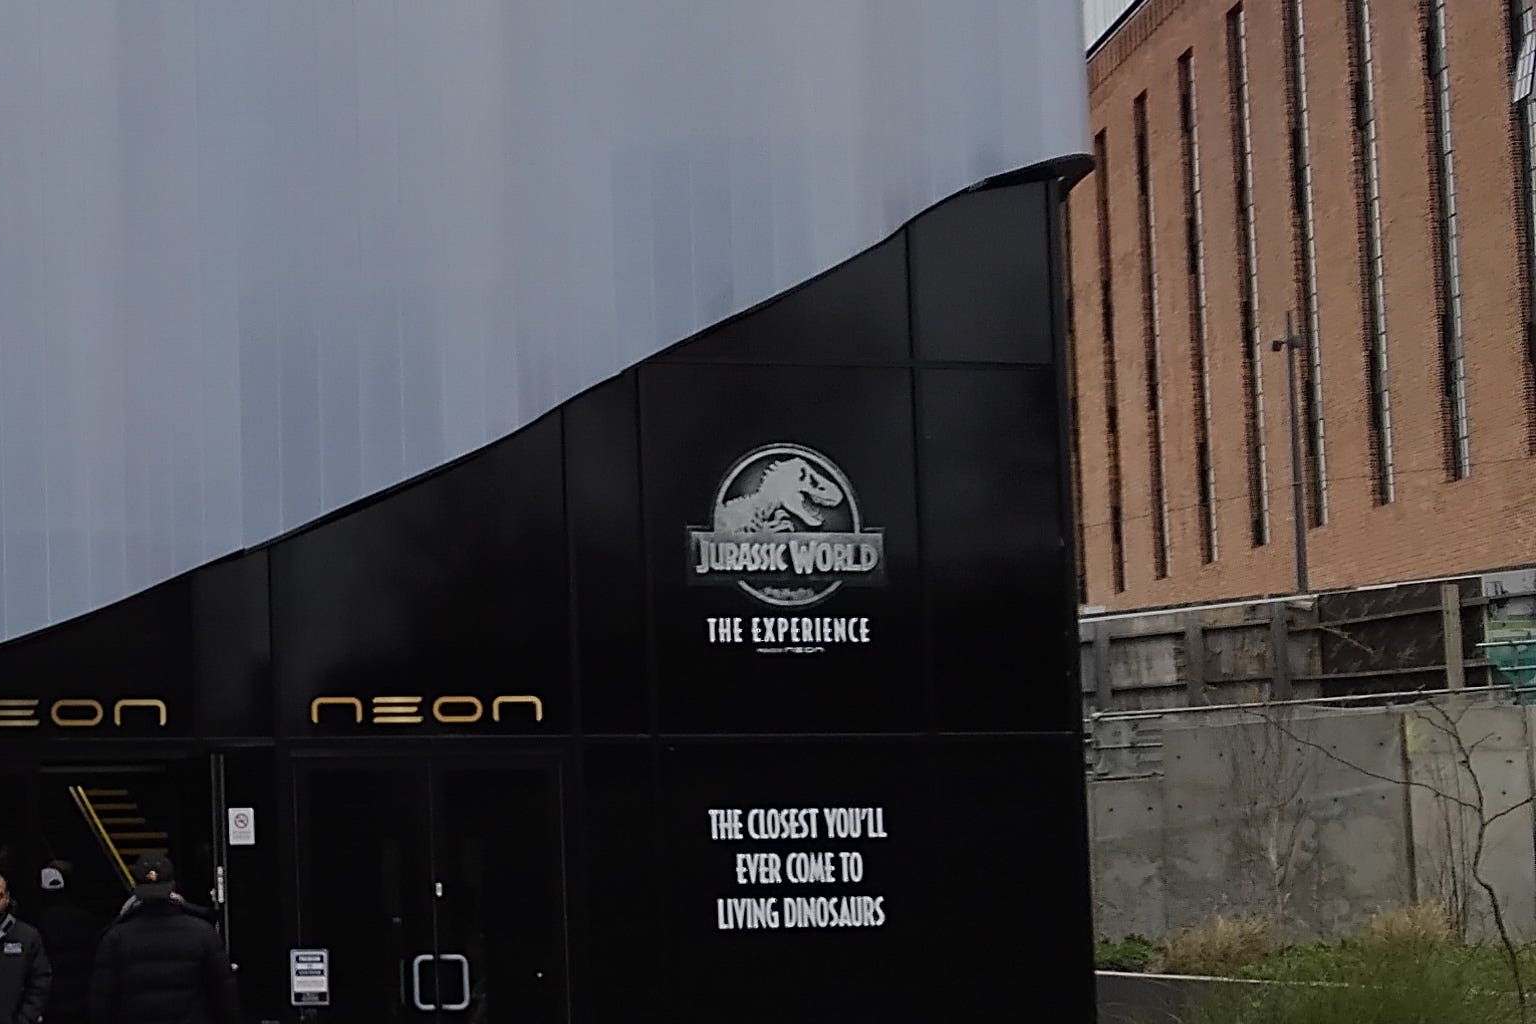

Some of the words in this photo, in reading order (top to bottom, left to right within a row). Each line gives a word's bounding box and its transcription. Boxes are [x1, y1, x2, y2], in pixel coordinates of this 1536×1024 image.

[695, 539, 787, 573] JURASSIC
[789, 540, 880, 574] WORLD
[706, 617, 743, 643] THE
[751, 617, 871, 643] EXPERIENCE
[708, 809, 744, 840] THE
[747, 808, 819, 839] CLOSEST
[823, 807, 888, 838] YOU'LL
[735, 853, 782, 884] EVER
[785, 852, 836, 883] COME
[838, 852, 864, 882] TO
[717, 897, 780, 929] LIVING
[783, 896, 886, 929] DINOSAURS
